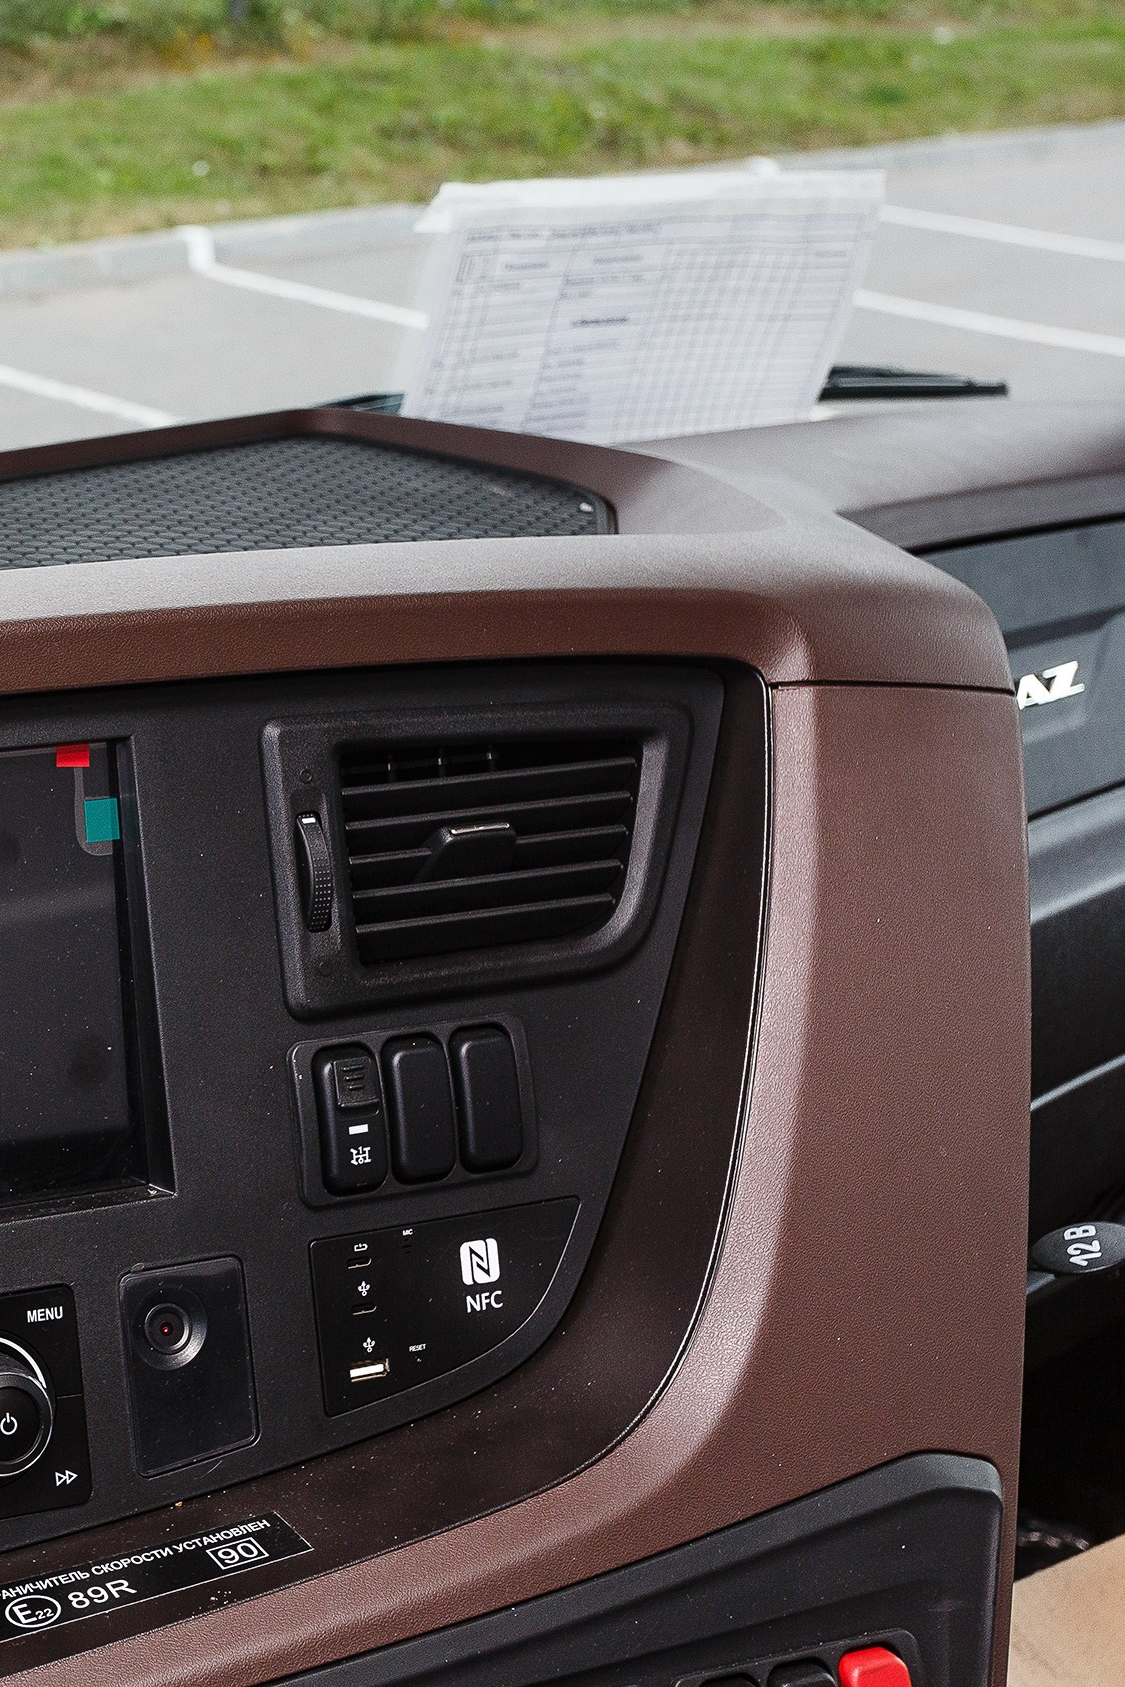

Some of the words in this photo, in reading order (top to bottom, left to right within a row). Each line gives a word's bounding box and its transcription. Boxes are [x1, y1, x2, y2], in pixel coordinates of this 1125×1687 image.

[466, 1290, 504, 1313] NFC
[26, 1306, 64, 1323] MENU
[409, 1343, 426, 1352] RESET
[91, 1546, 174, 1577] СКОРОСТИ
[171, 1518, 271, 1554] УСТАНОВЛЕН
[216, 1540, 259, 1565] 90
[67, 1578, 138, 1609] 89R
